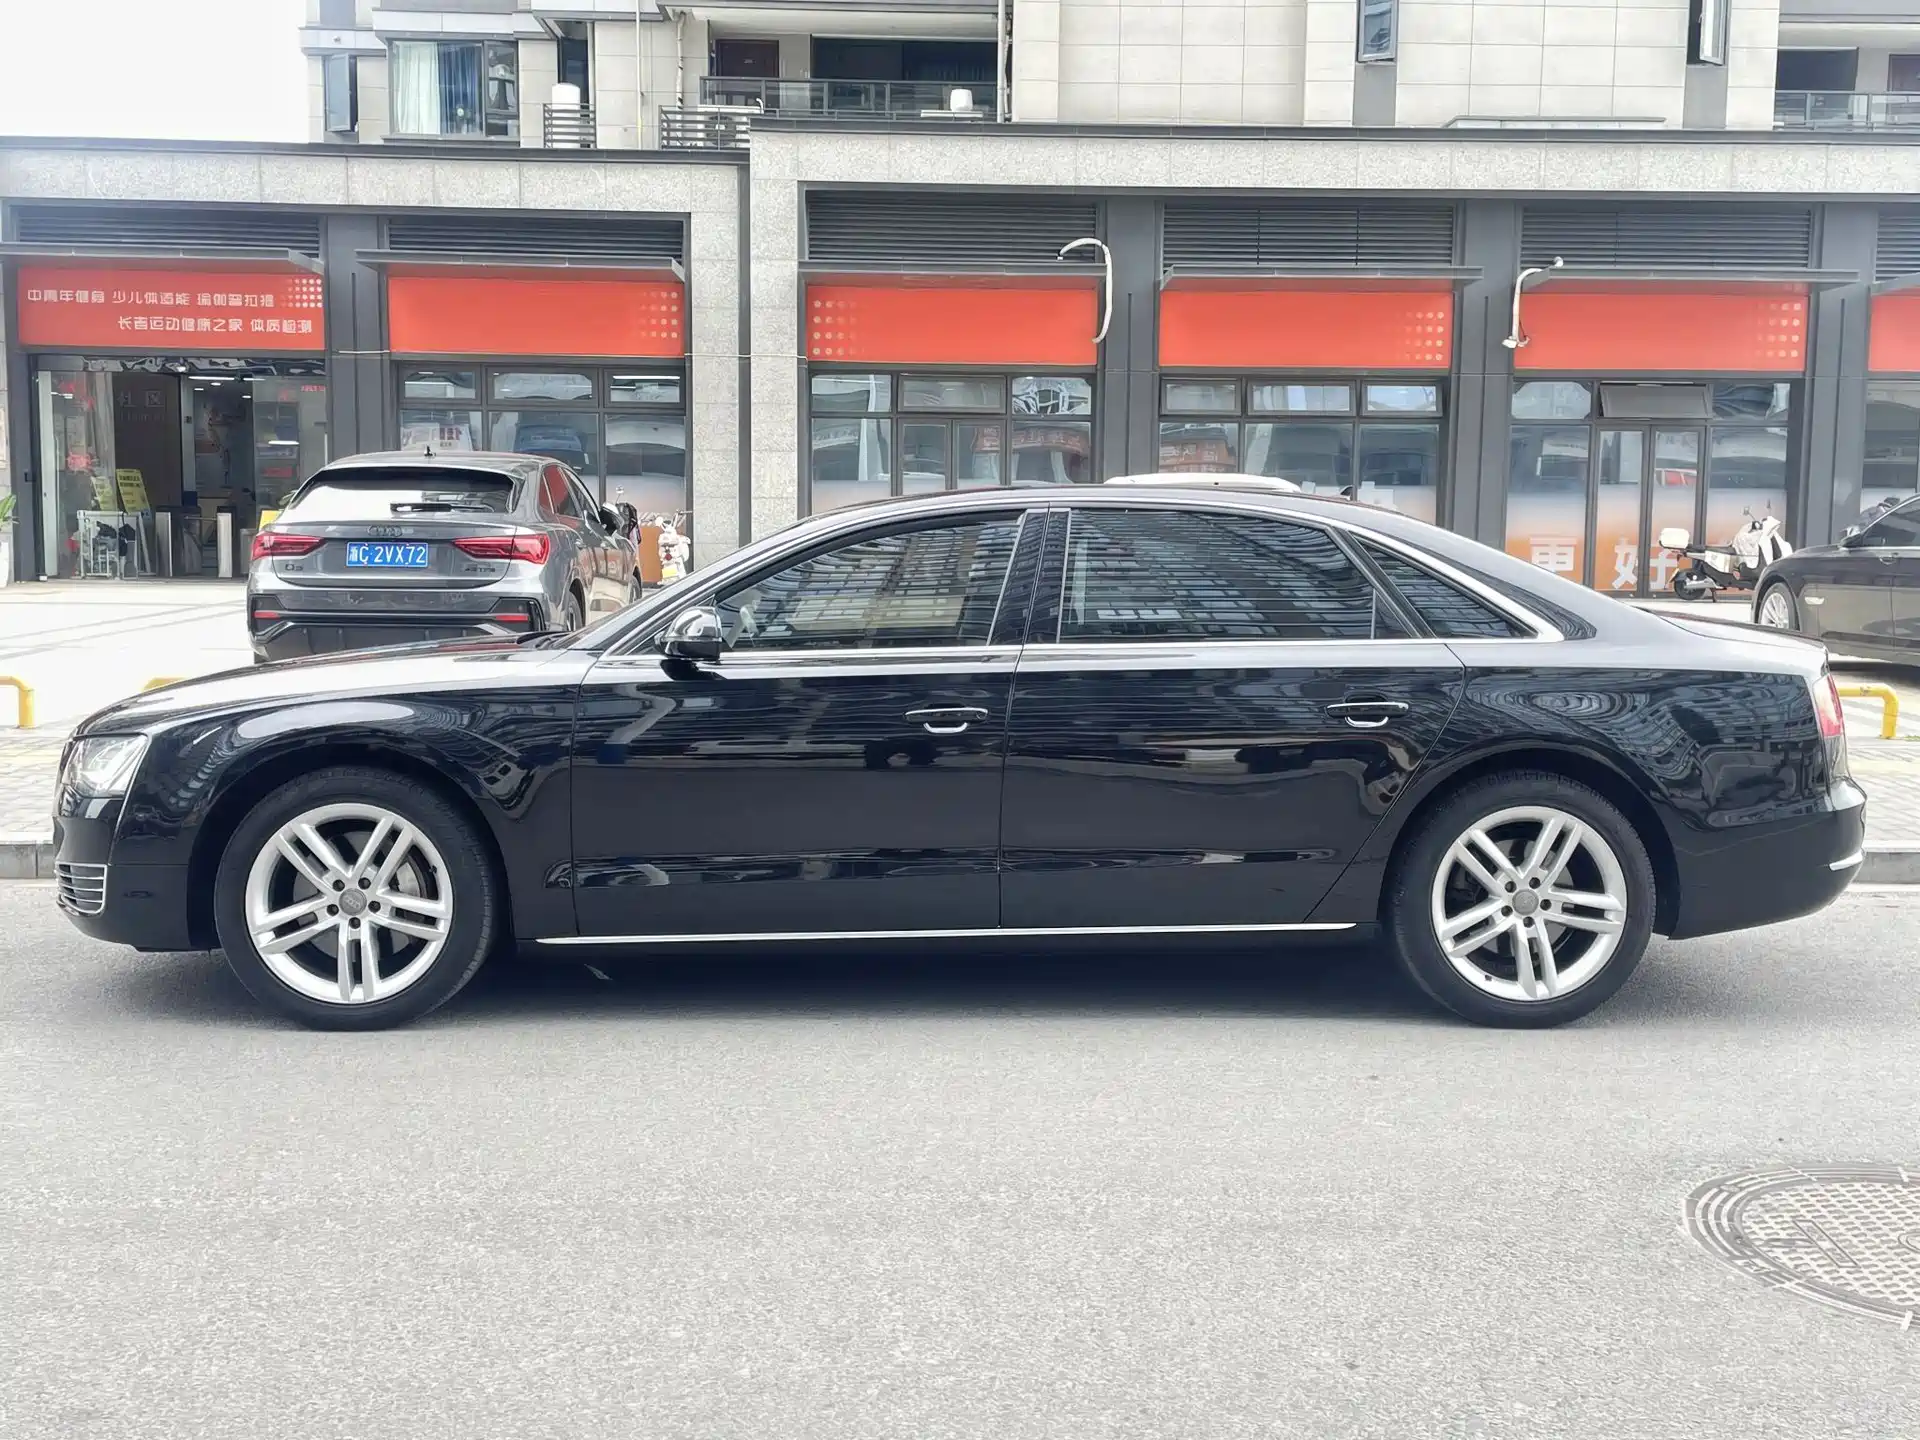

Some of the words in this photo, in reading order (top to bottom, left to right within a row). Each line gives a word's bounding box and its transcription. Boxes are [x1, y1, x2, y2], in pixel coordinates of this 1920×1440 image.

[117, 316, 243, 332] 长者运动健康之家
[250, 318, 313, 334] 体质检测
